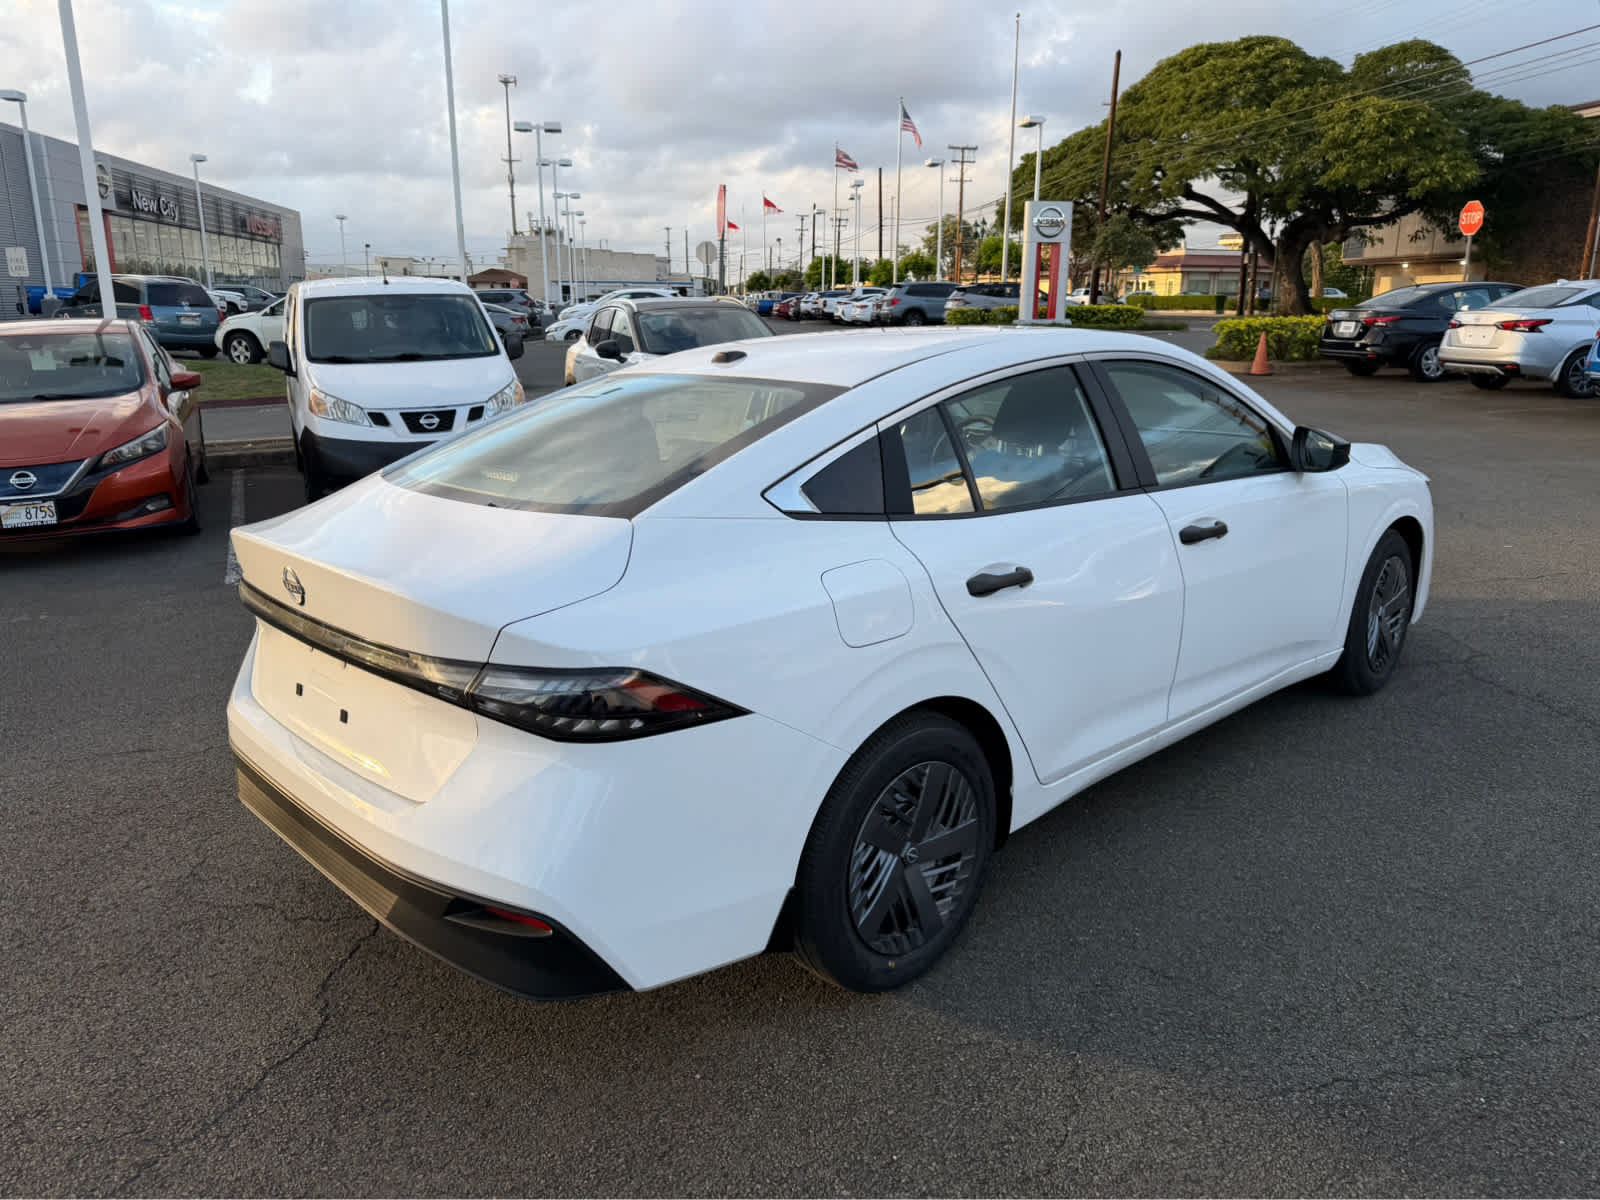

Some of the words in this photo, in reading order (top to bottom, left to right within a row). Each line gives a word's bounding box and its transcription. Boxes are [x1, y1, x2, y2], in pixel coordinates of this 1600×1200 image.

[132, 190, 157, 213] New
[160, 195, 179, 223] City
[1462, 211, 1482, 225] STOP
